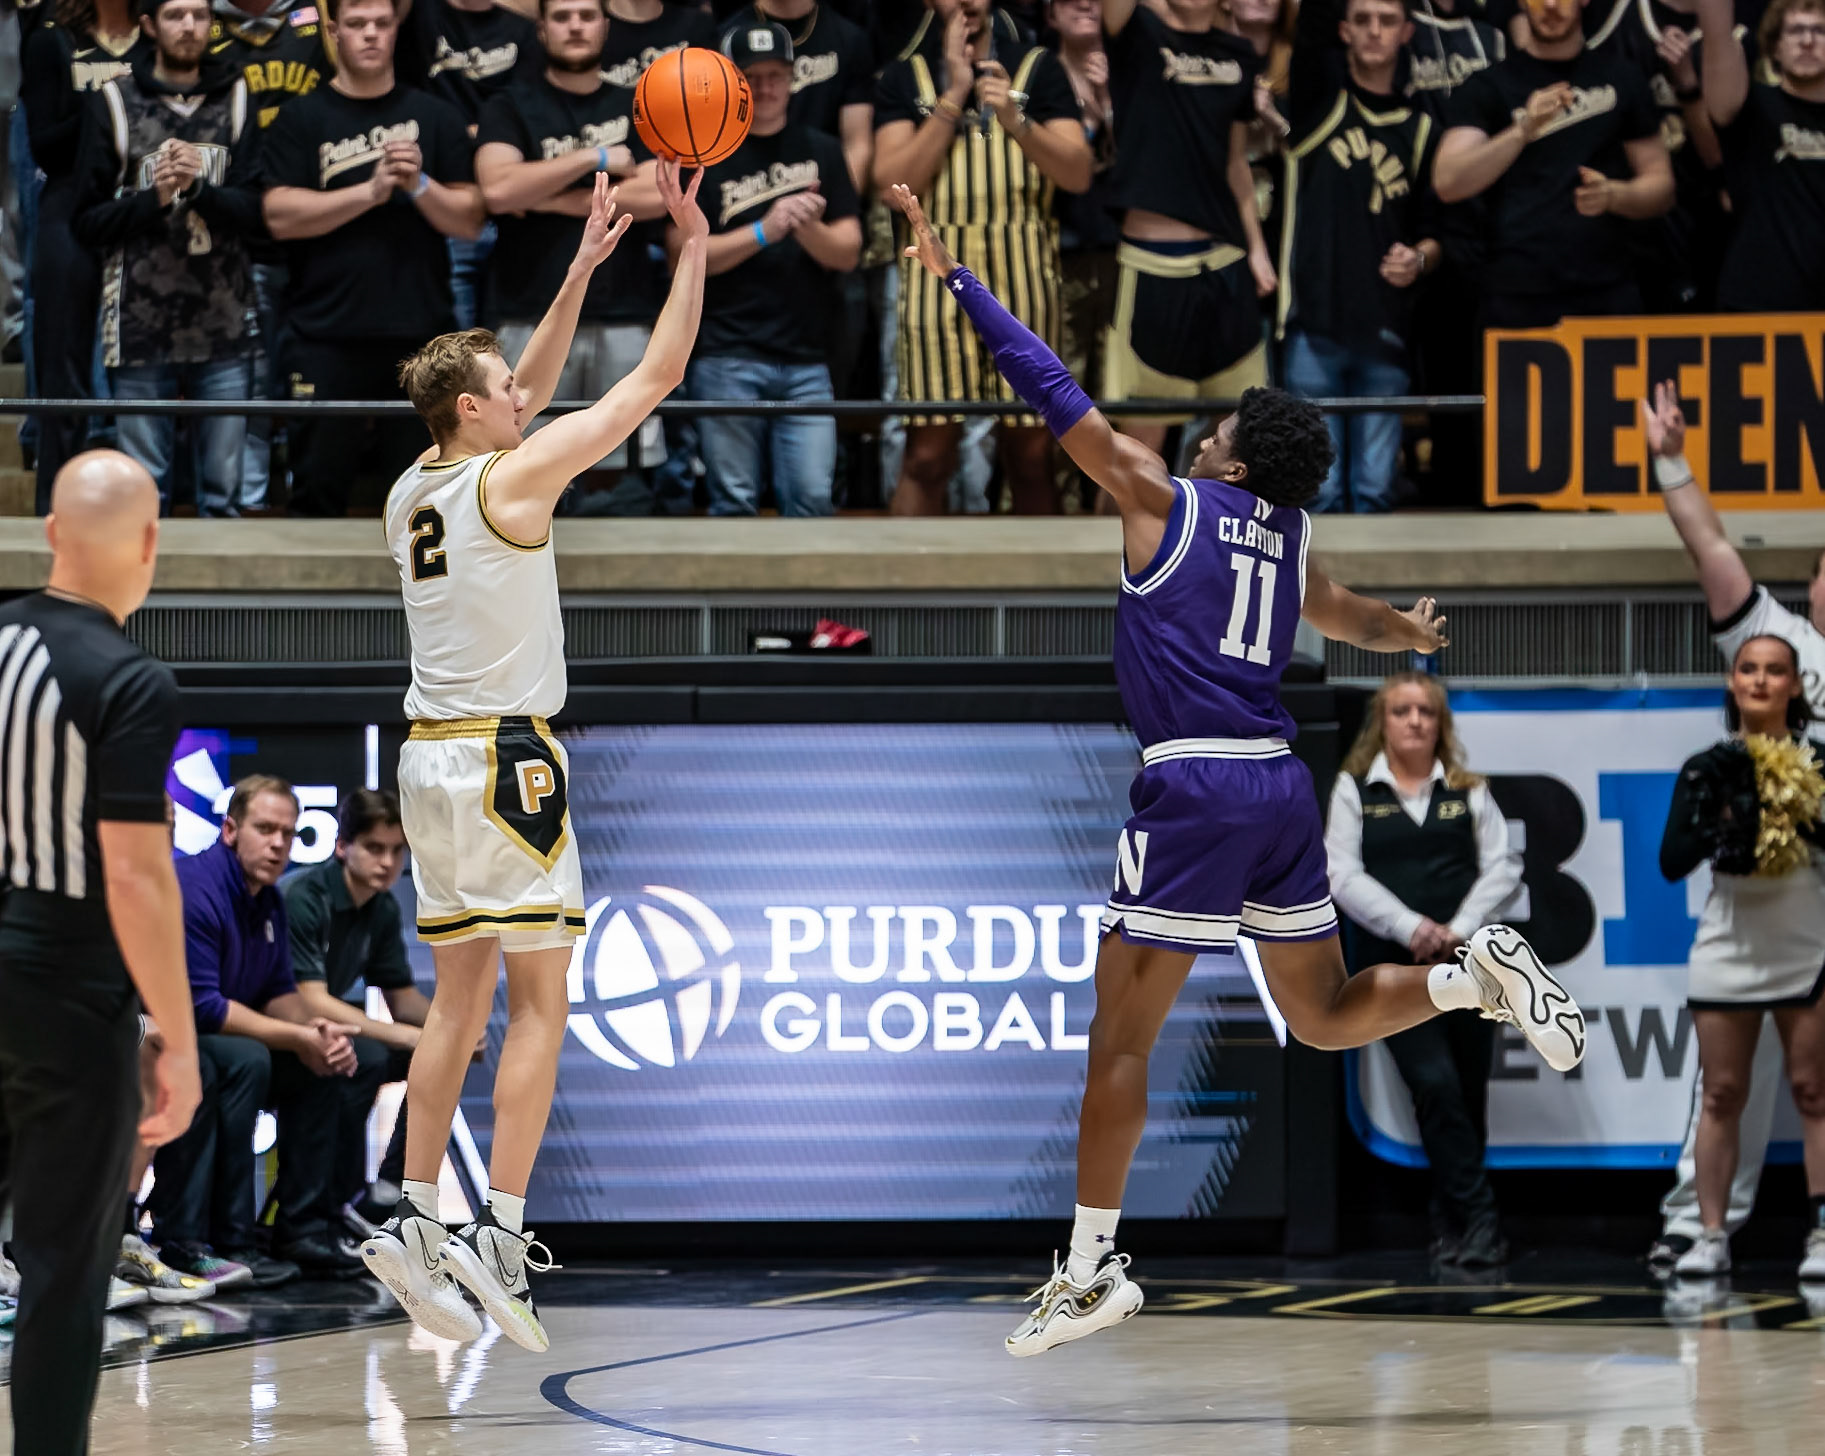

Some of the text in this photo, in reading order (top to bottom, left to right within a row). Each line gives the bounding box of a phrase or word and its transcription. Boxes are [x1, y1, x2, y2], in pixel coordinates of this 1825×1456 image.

[1497, 333, 1825, 496] DEFEN
[408, 505, 448, 583] 2
[1218, 516, 1284, 560] CLAYTON
[1219, 552, 1277, 666] 11
[515, 759, 556, 814] P
[1114, 828, 1149, 896] N
[760, 991, 1089, 1053] GLOBAL
